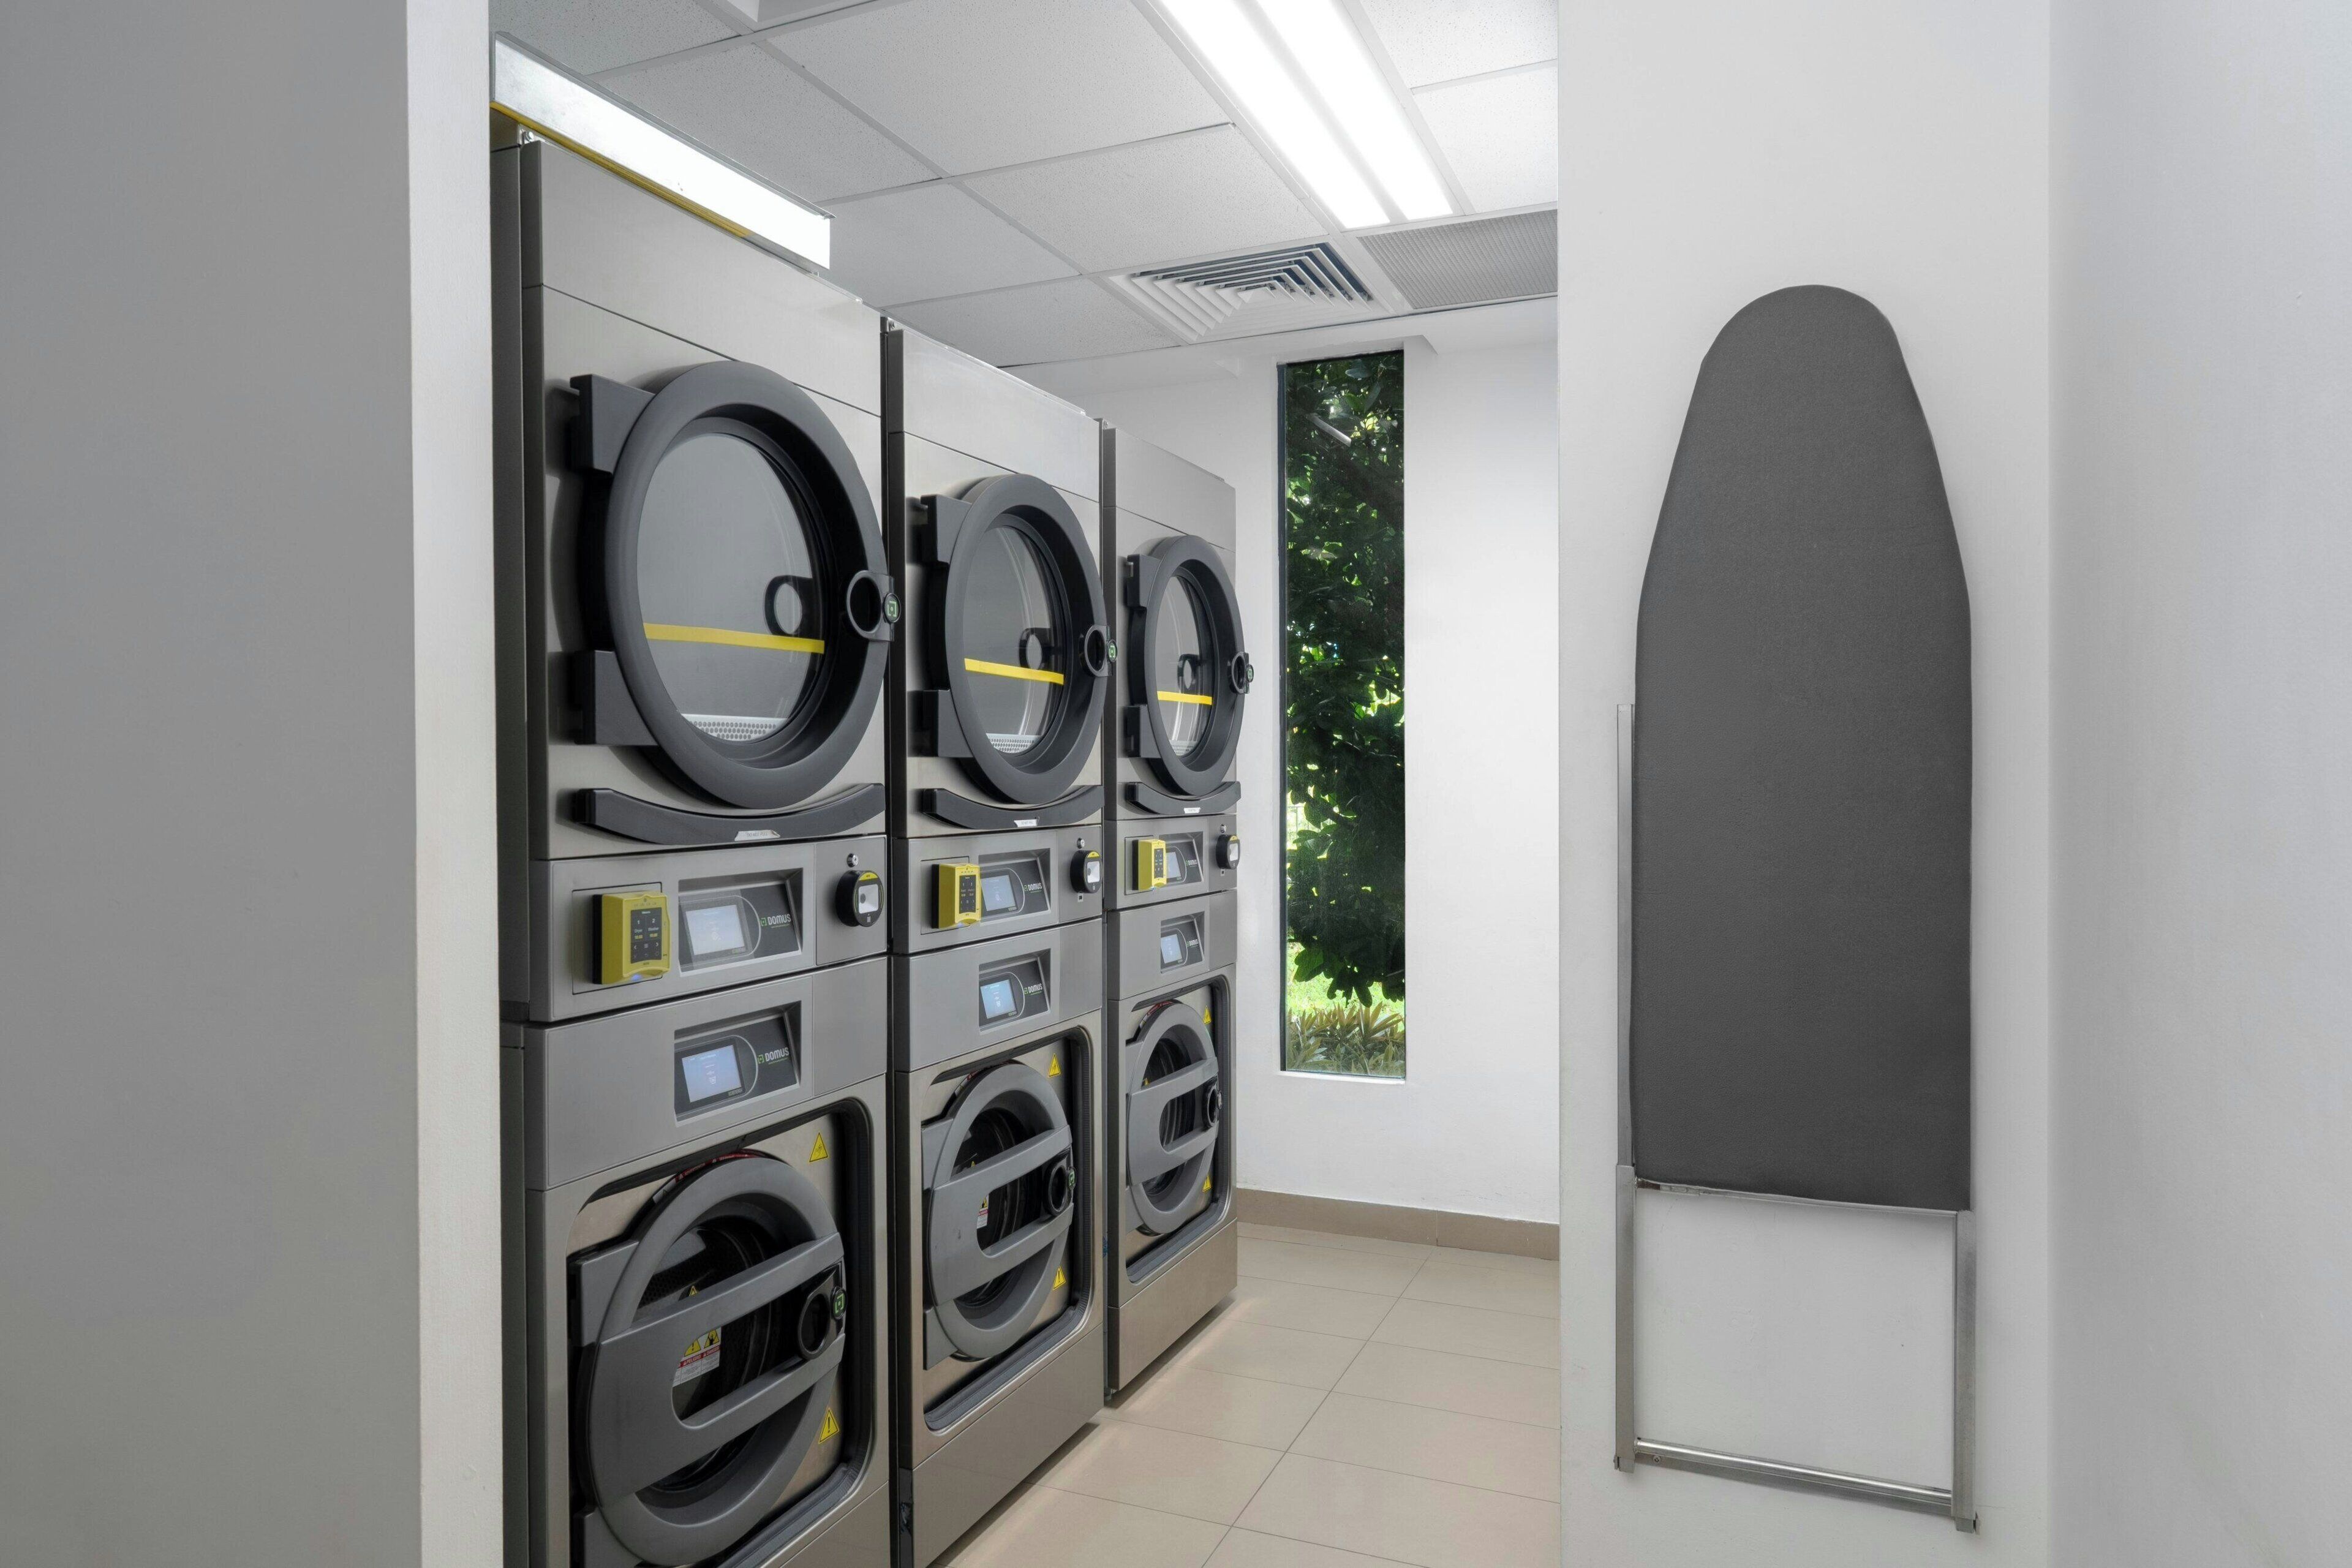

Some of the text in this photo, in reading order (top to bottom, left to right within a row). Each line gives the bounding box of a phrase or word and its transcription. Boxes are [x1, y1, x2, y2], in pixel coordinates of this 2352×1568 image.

[1027, 883, 1042, 891] DOMUS
[767, 913, 791, 925] DOMUS
[1028, 983, 1042, 993] DOMUS
[764, 1047, 790, 1061] DOMUS
